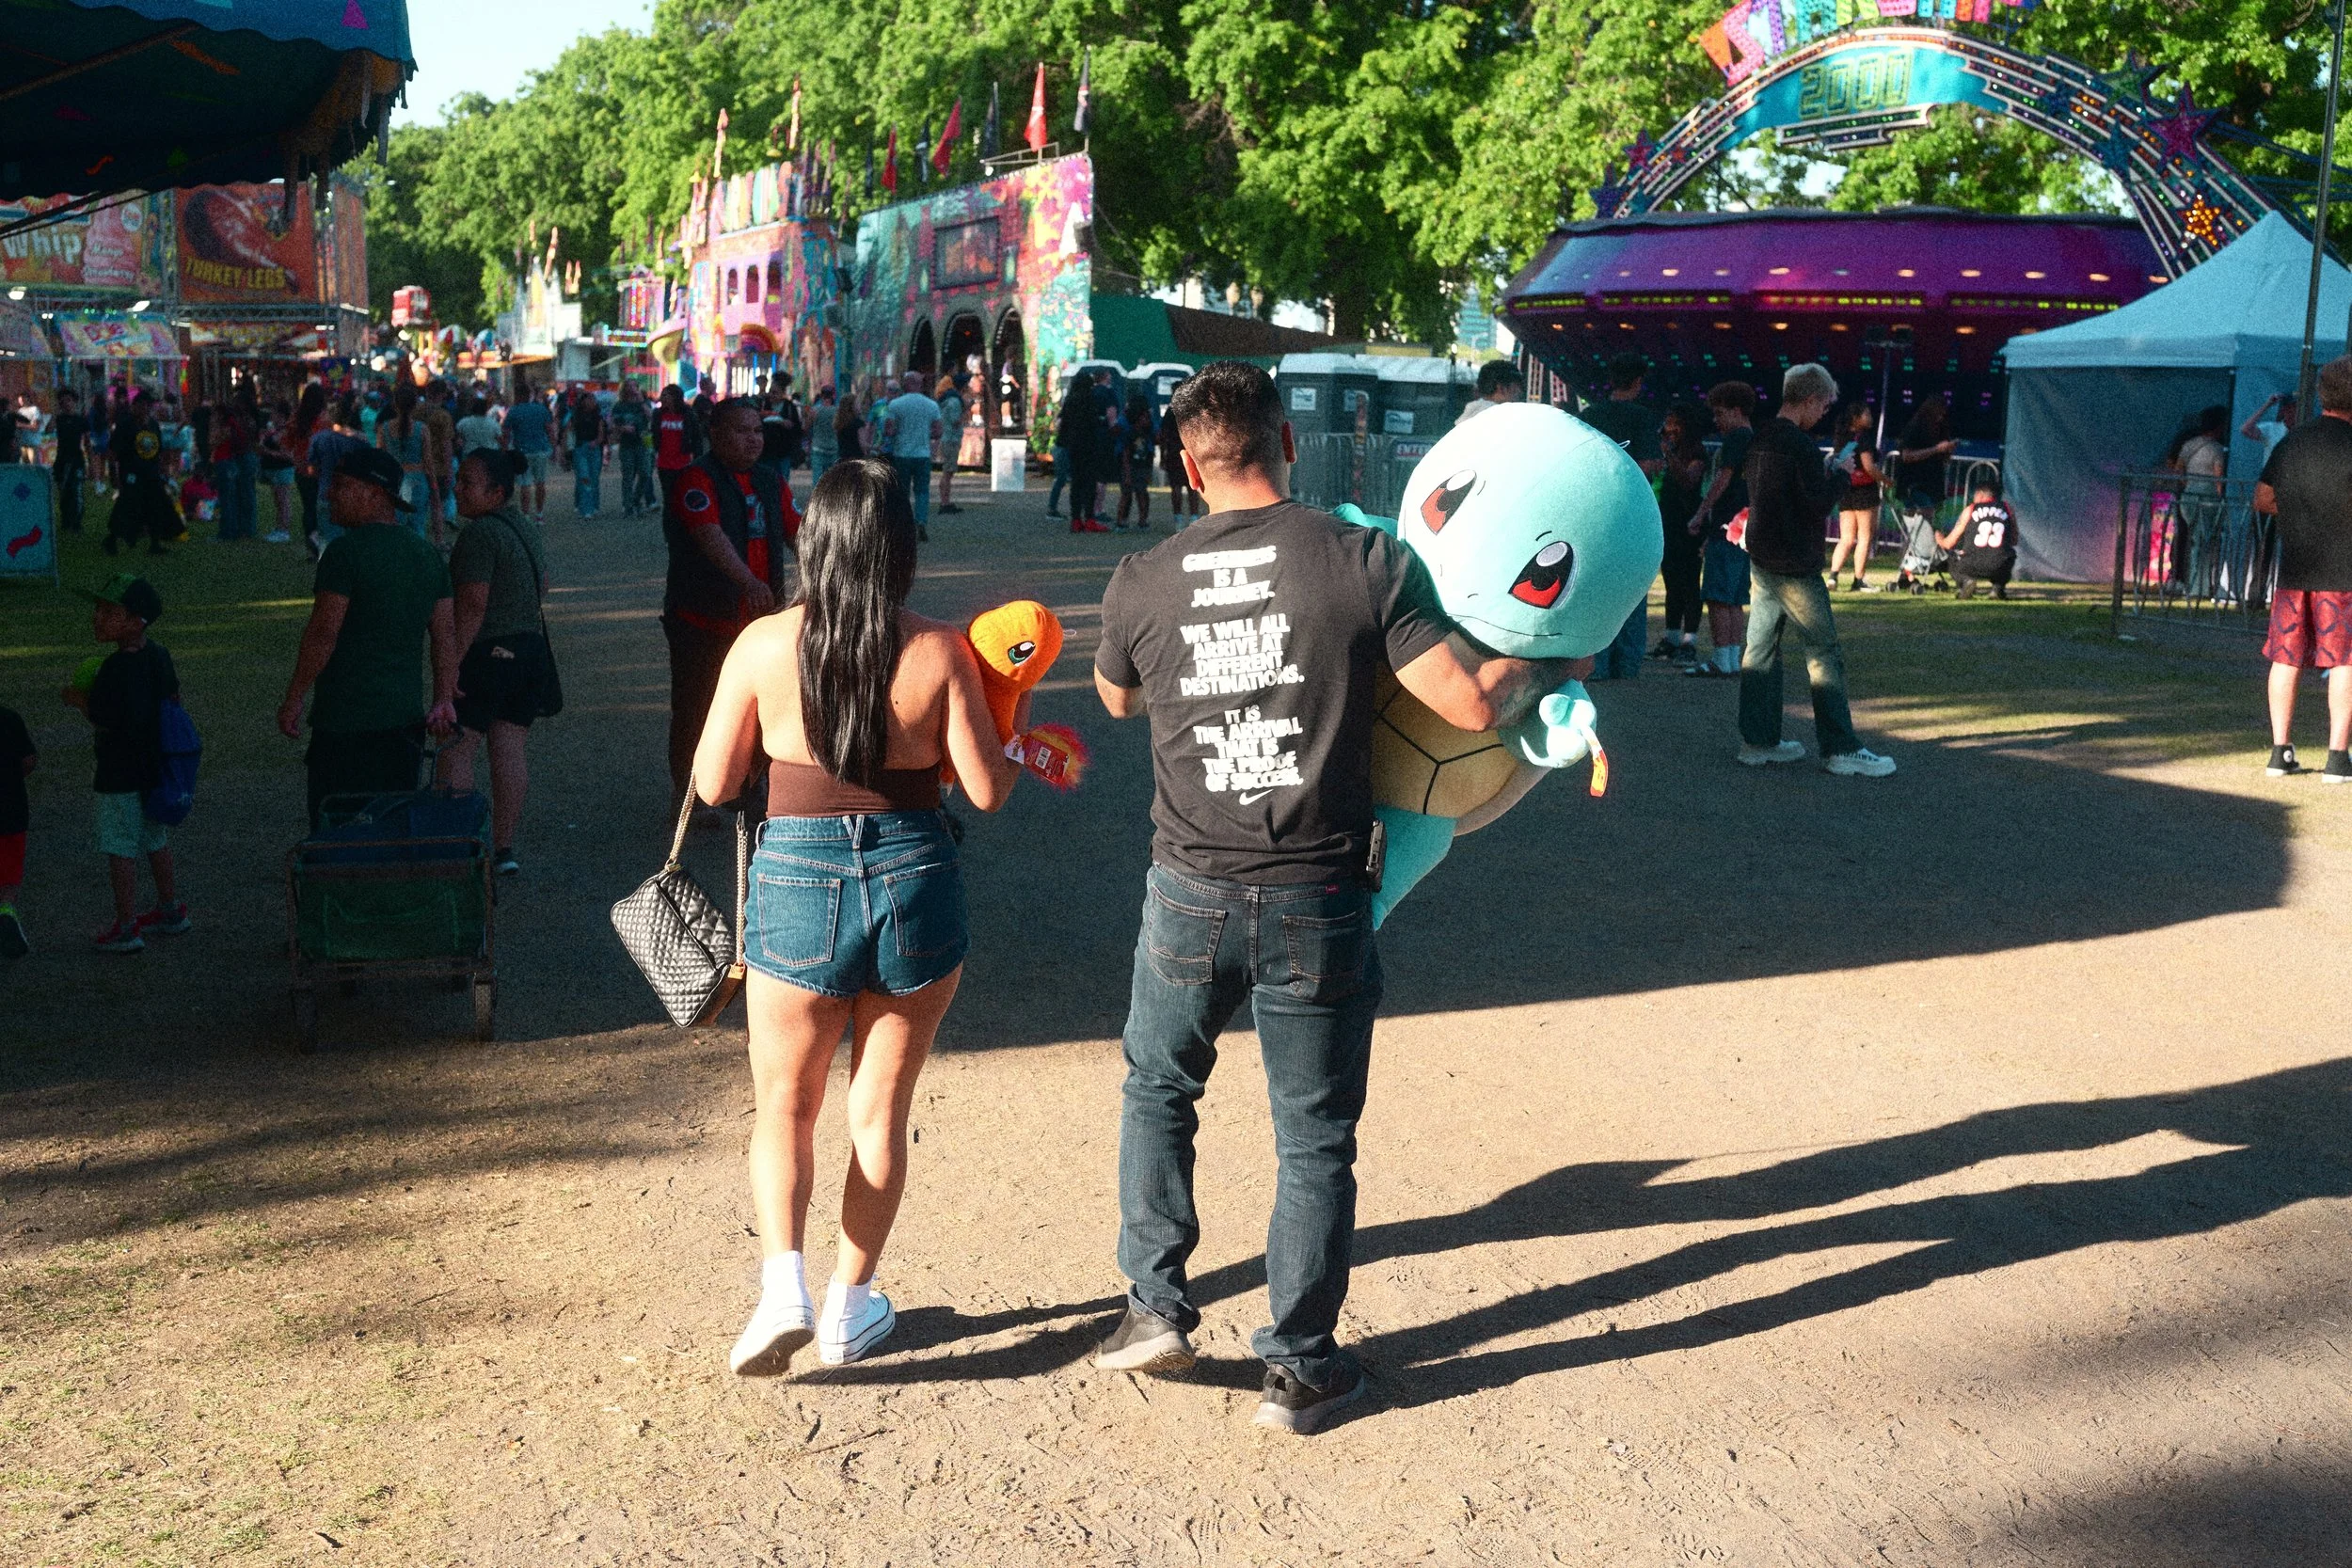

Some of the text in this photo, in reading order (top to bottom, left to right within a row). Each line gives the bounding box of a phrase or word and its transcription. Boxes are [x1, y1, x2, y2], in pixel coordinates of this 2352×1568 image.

[1799, 47, 1914, 120] 2000
[3, 225, 82, 263] Whip
[186, 256, 286, 290] TURKEY LEGS
[1974, 520, 2005, 548] 33
[1214, 567, 1248, 587] IS A
[1180, 613, 1291, 644] WE WILL ALL
[1193, 632, 1283, 660] ARRIVE AT
[1196, 650, 1283, 677] DIFFERENT
[1180, 664, 1305, 696] DESTINATIONS.
[1225, 705, 1261, 724] IT IS
[1193, 717, 1303, 744] THE ARRIVAL
[1215, 737, 1279, 758] THAT IS
[1202, 751, 1296, 774] THE PROOF
[1205, 773, 1229, 792] OF
